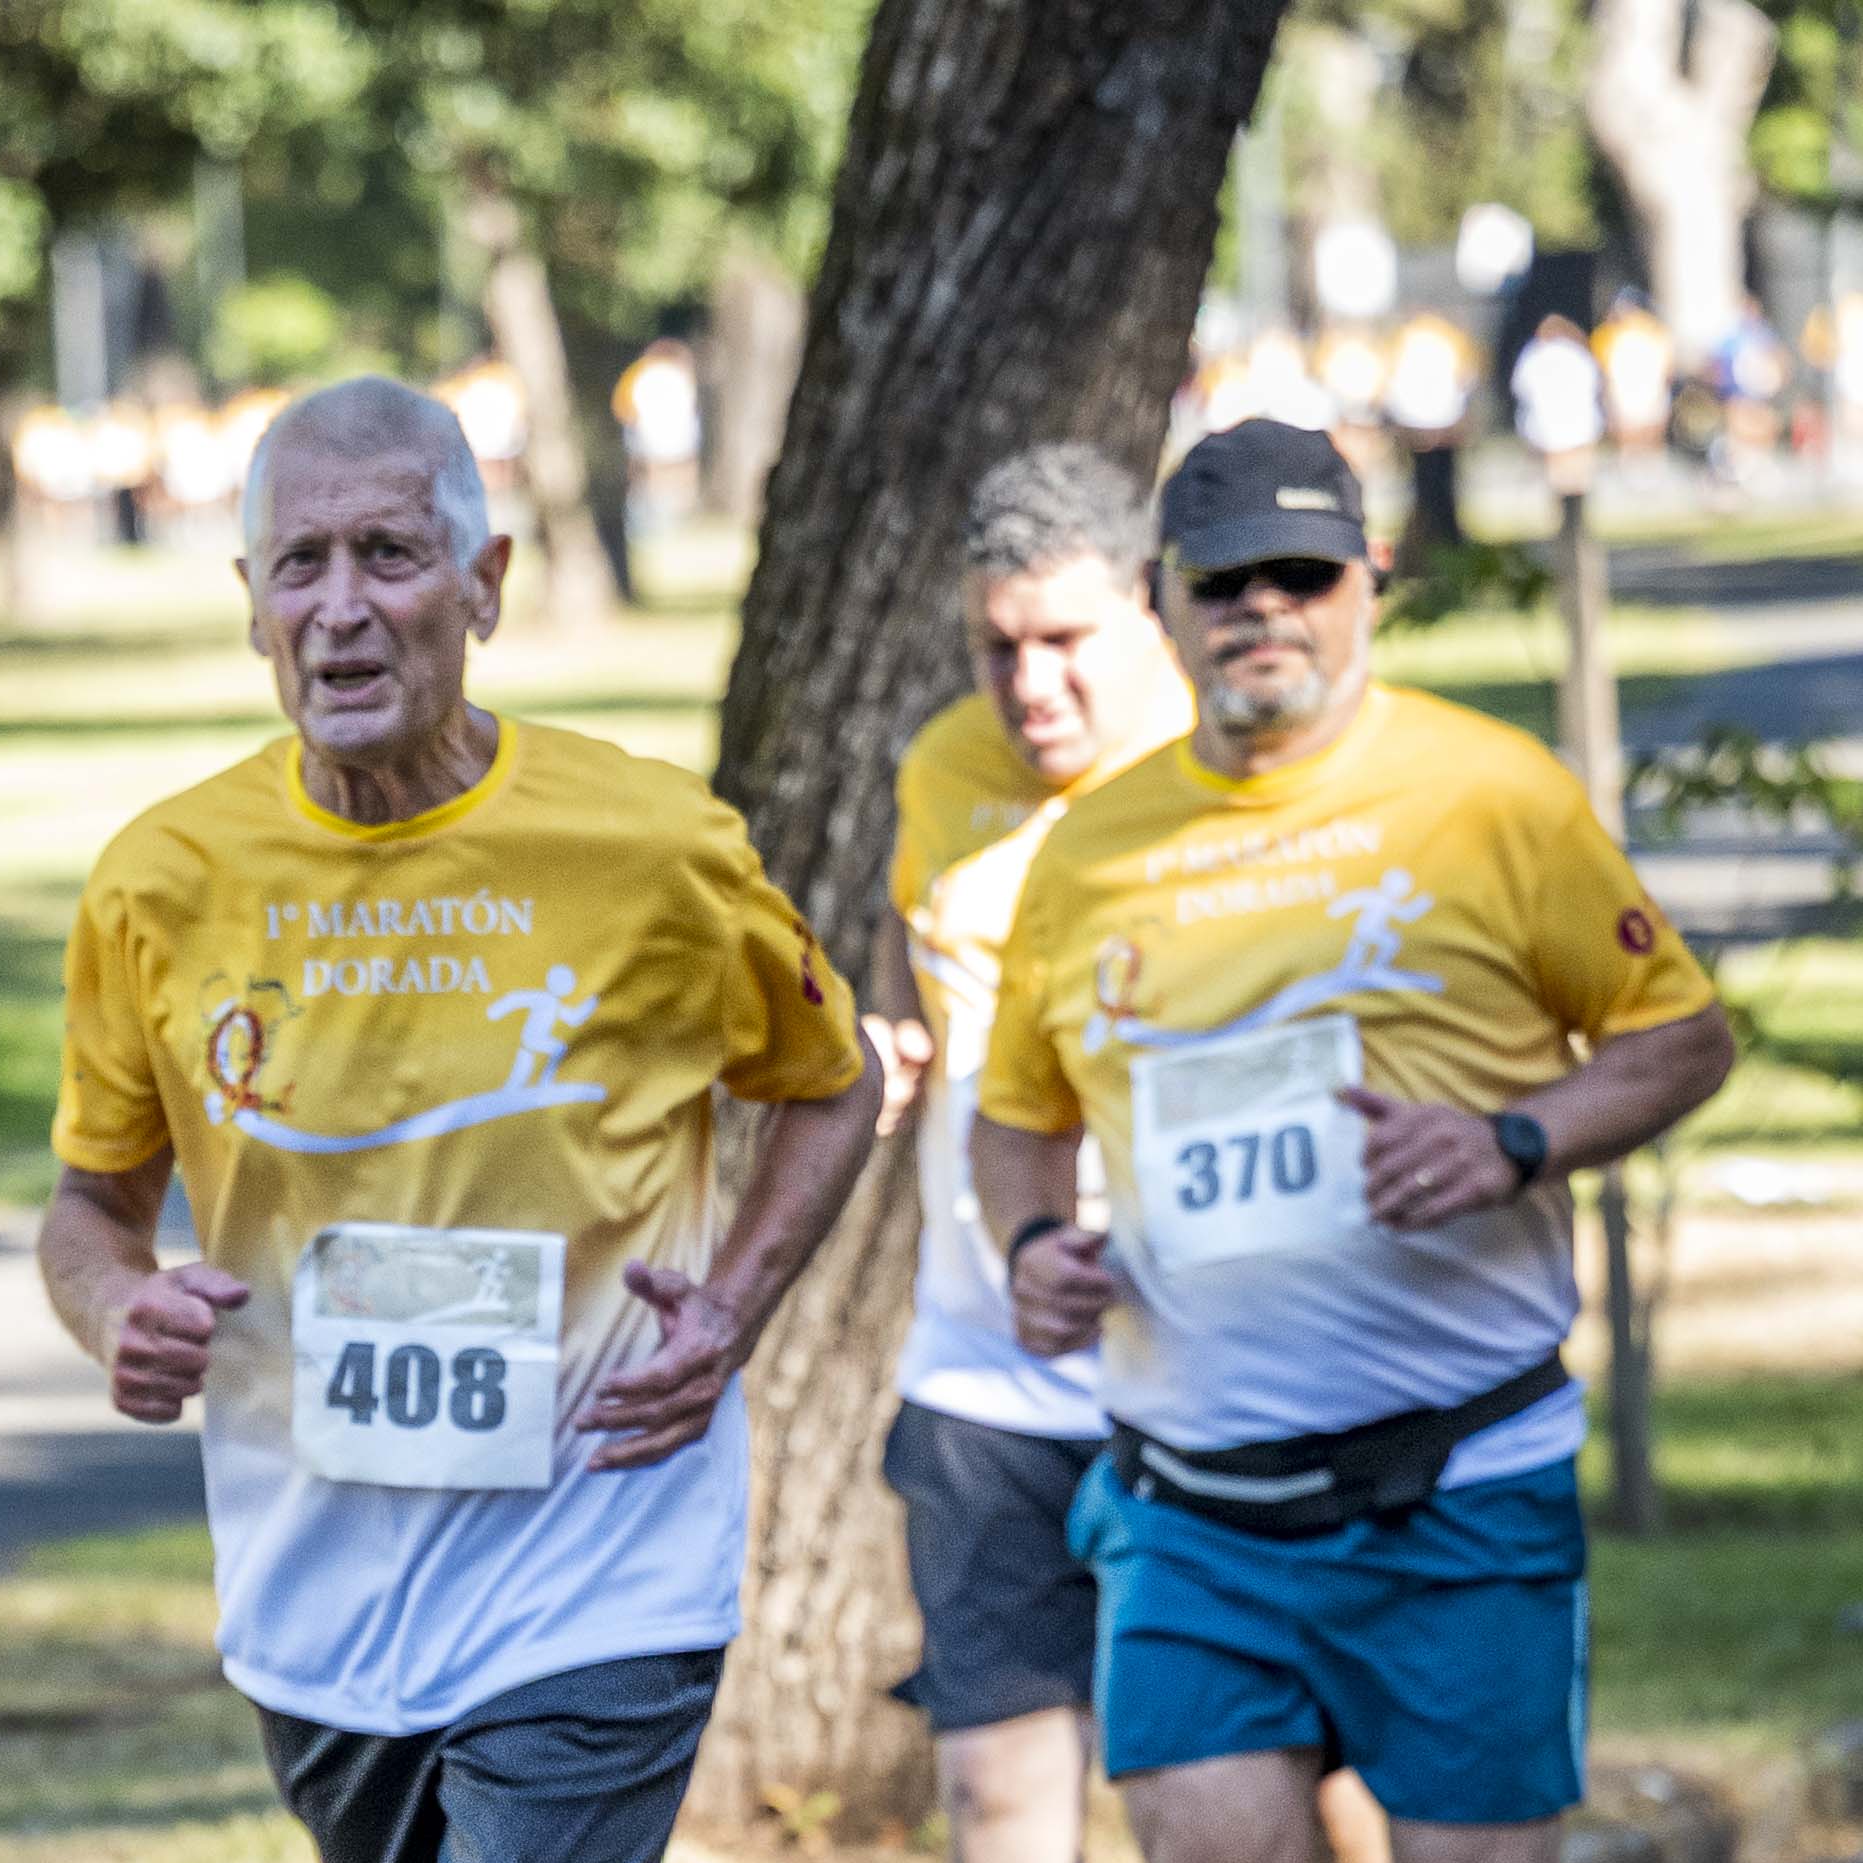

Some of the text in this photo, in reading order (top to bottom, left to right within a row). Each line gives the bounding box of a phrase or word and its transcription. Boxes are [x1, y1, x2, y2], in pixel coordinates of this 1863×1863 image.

[307, 887, 534, 939] MARATÓN
[302, 954, 494, 998] DORADA
[1174, 1123, 1318, 1211] 370
[326, 1341, 508, 1432] 408
